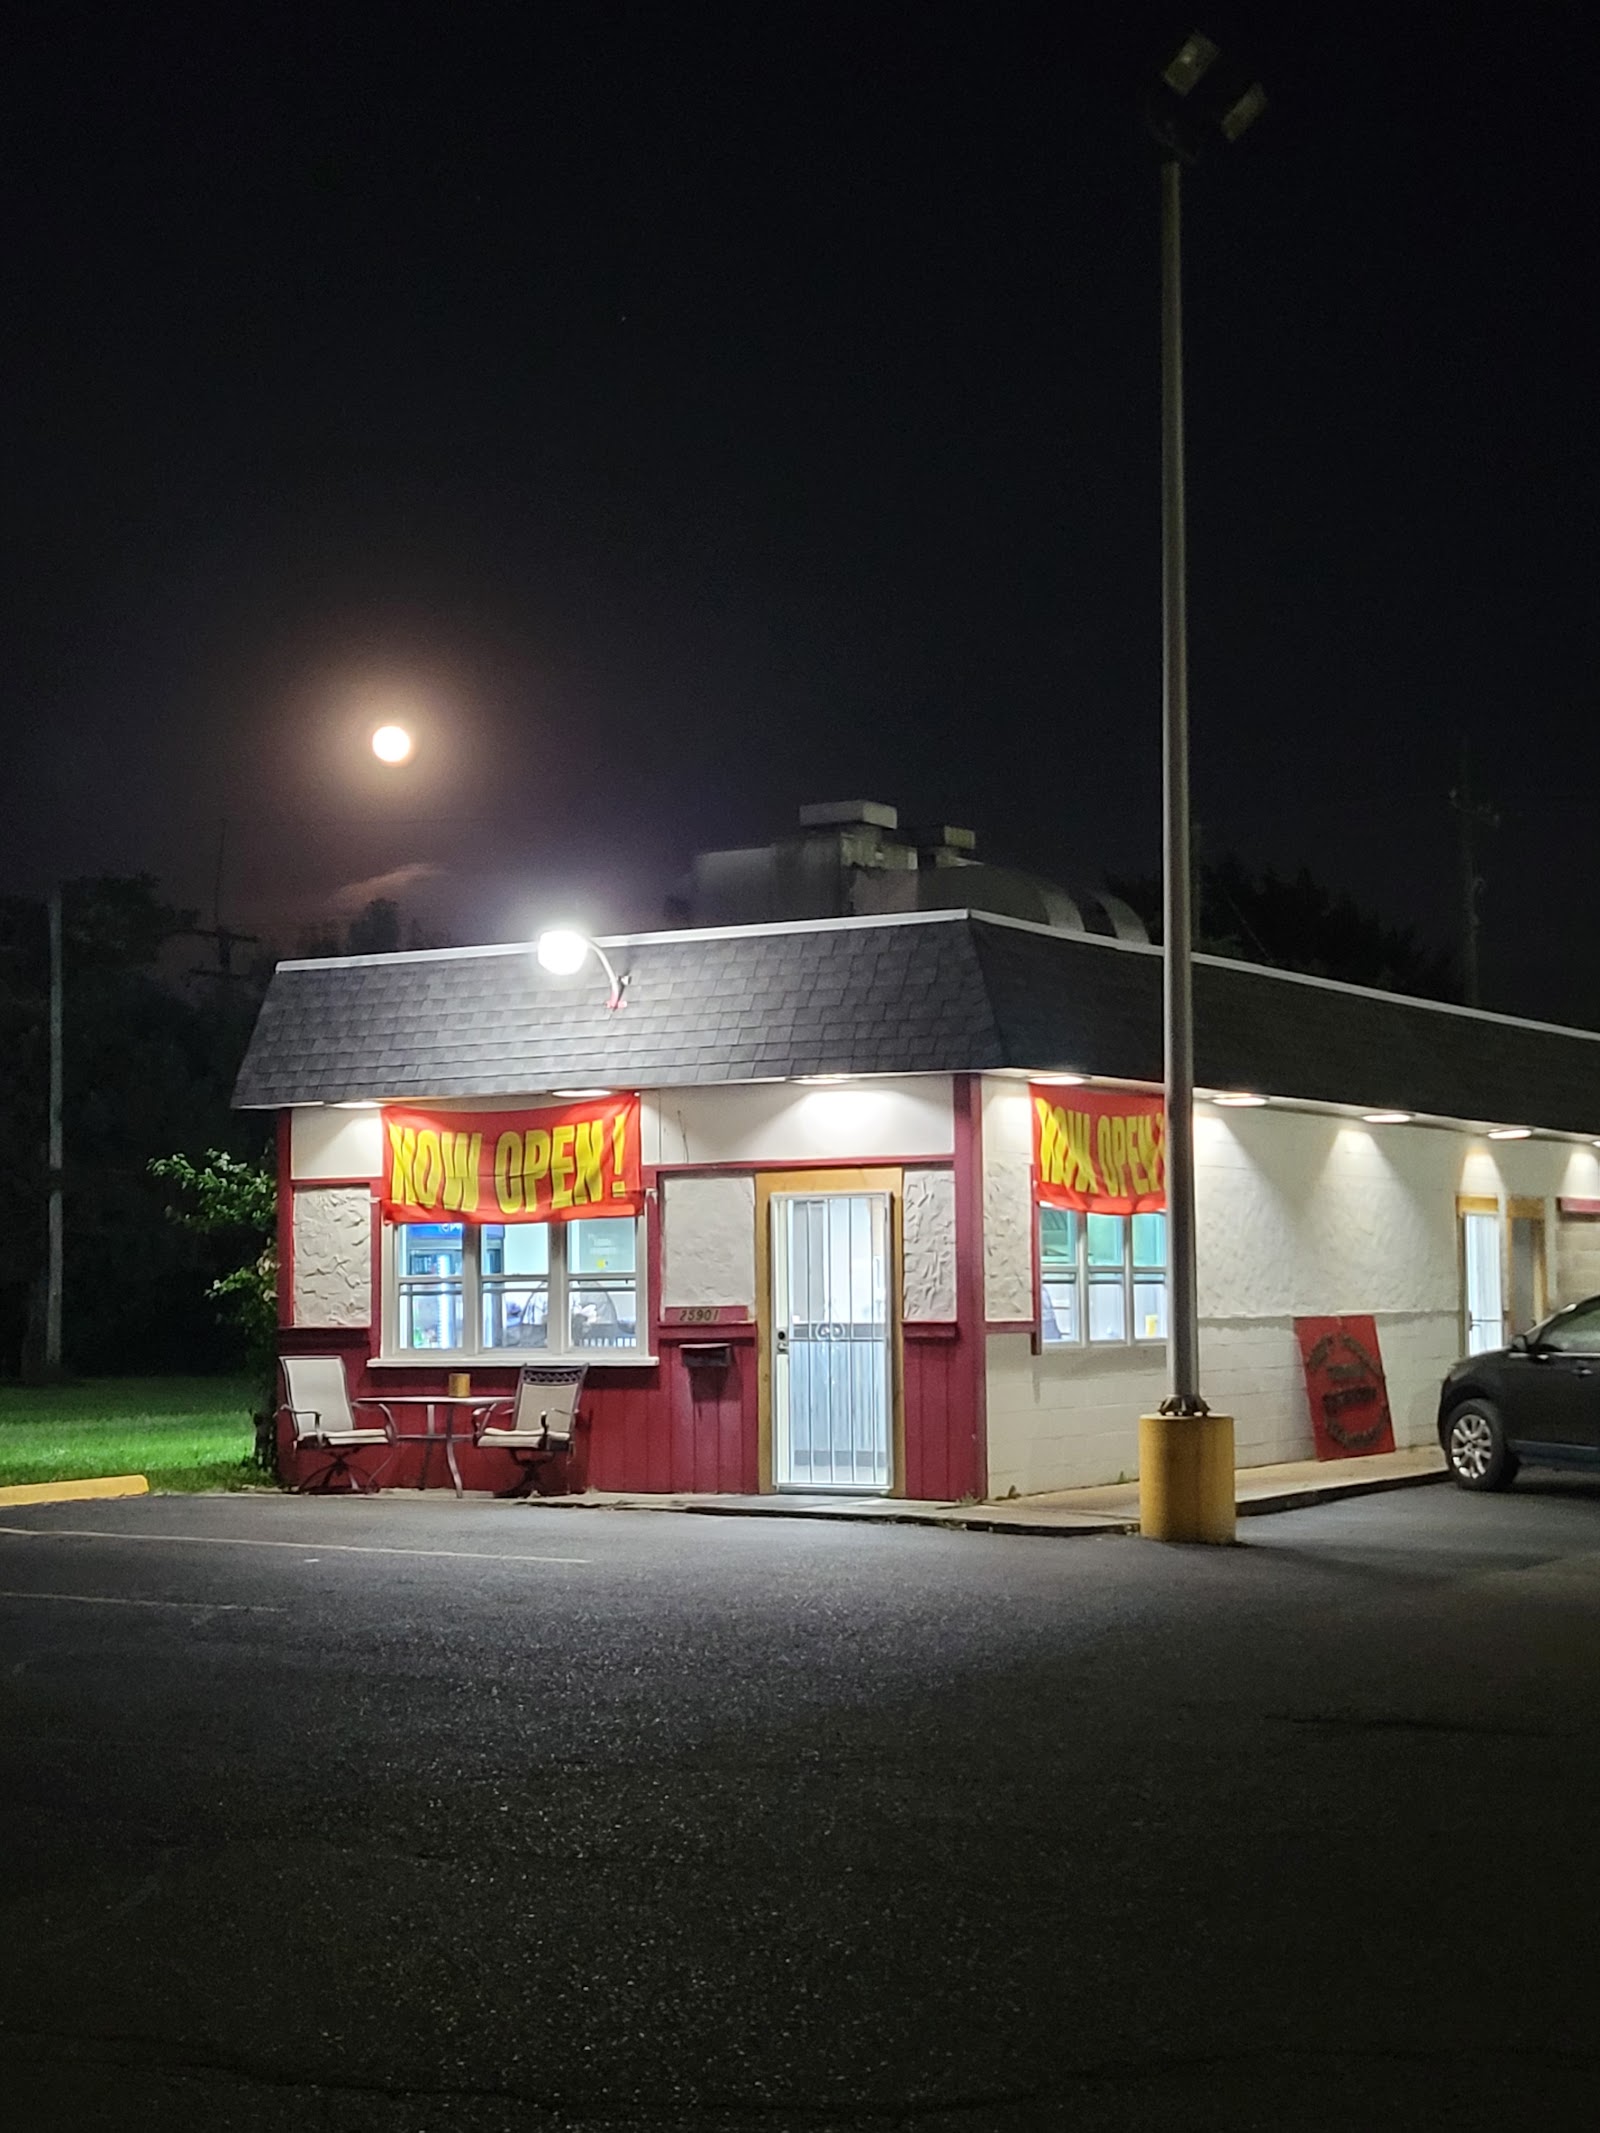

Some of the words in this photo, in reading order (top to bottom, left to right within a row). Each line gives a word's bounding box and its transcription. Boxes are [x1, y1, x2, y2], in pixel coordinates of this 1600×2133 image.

[388, 1122, 483, 1213] NOW
[1034, 1097, 1099, 1195] NOW
[679, 1308, 719, 1322] 25901
